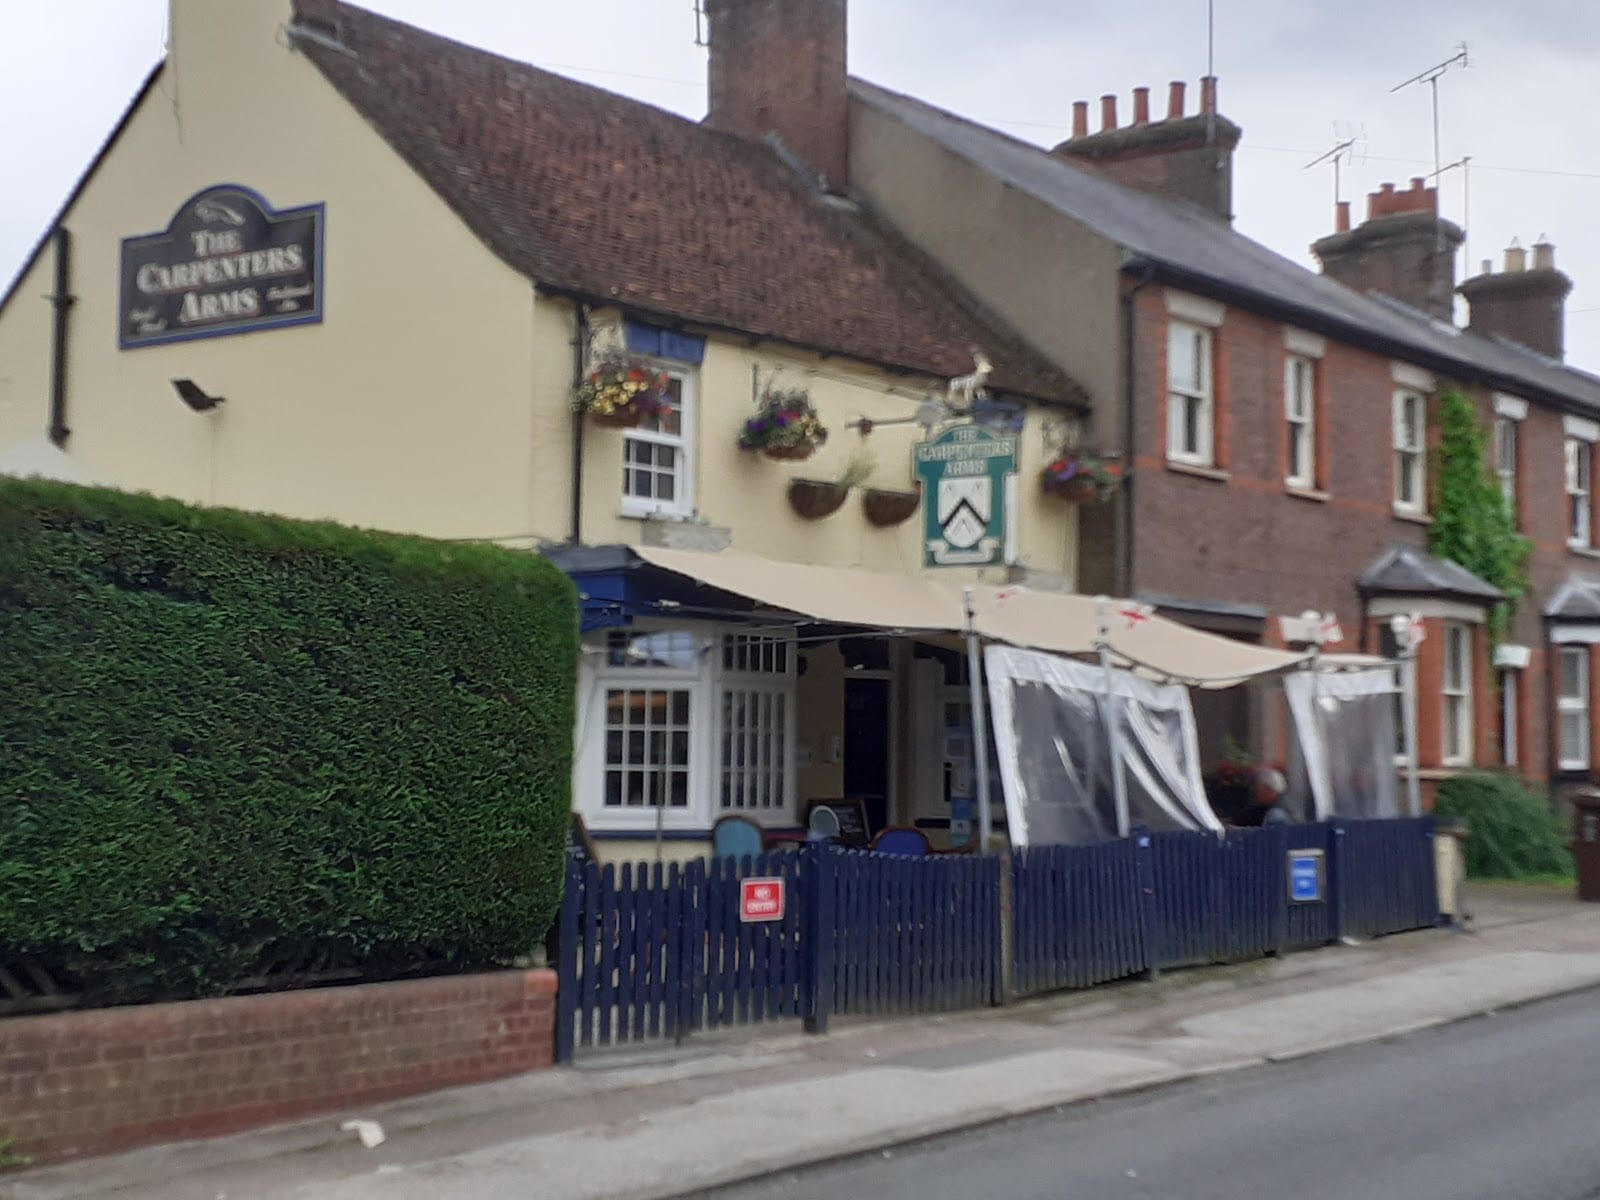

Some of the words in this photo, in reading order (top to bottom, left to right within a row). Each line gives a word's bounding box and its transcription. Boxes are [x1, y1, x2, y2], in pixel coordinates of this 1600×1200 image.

[191, 229, 241, 256] THE
[136, 244, 303, 294] CARPENTERS
[178, 287, 258, 323] ARMS
